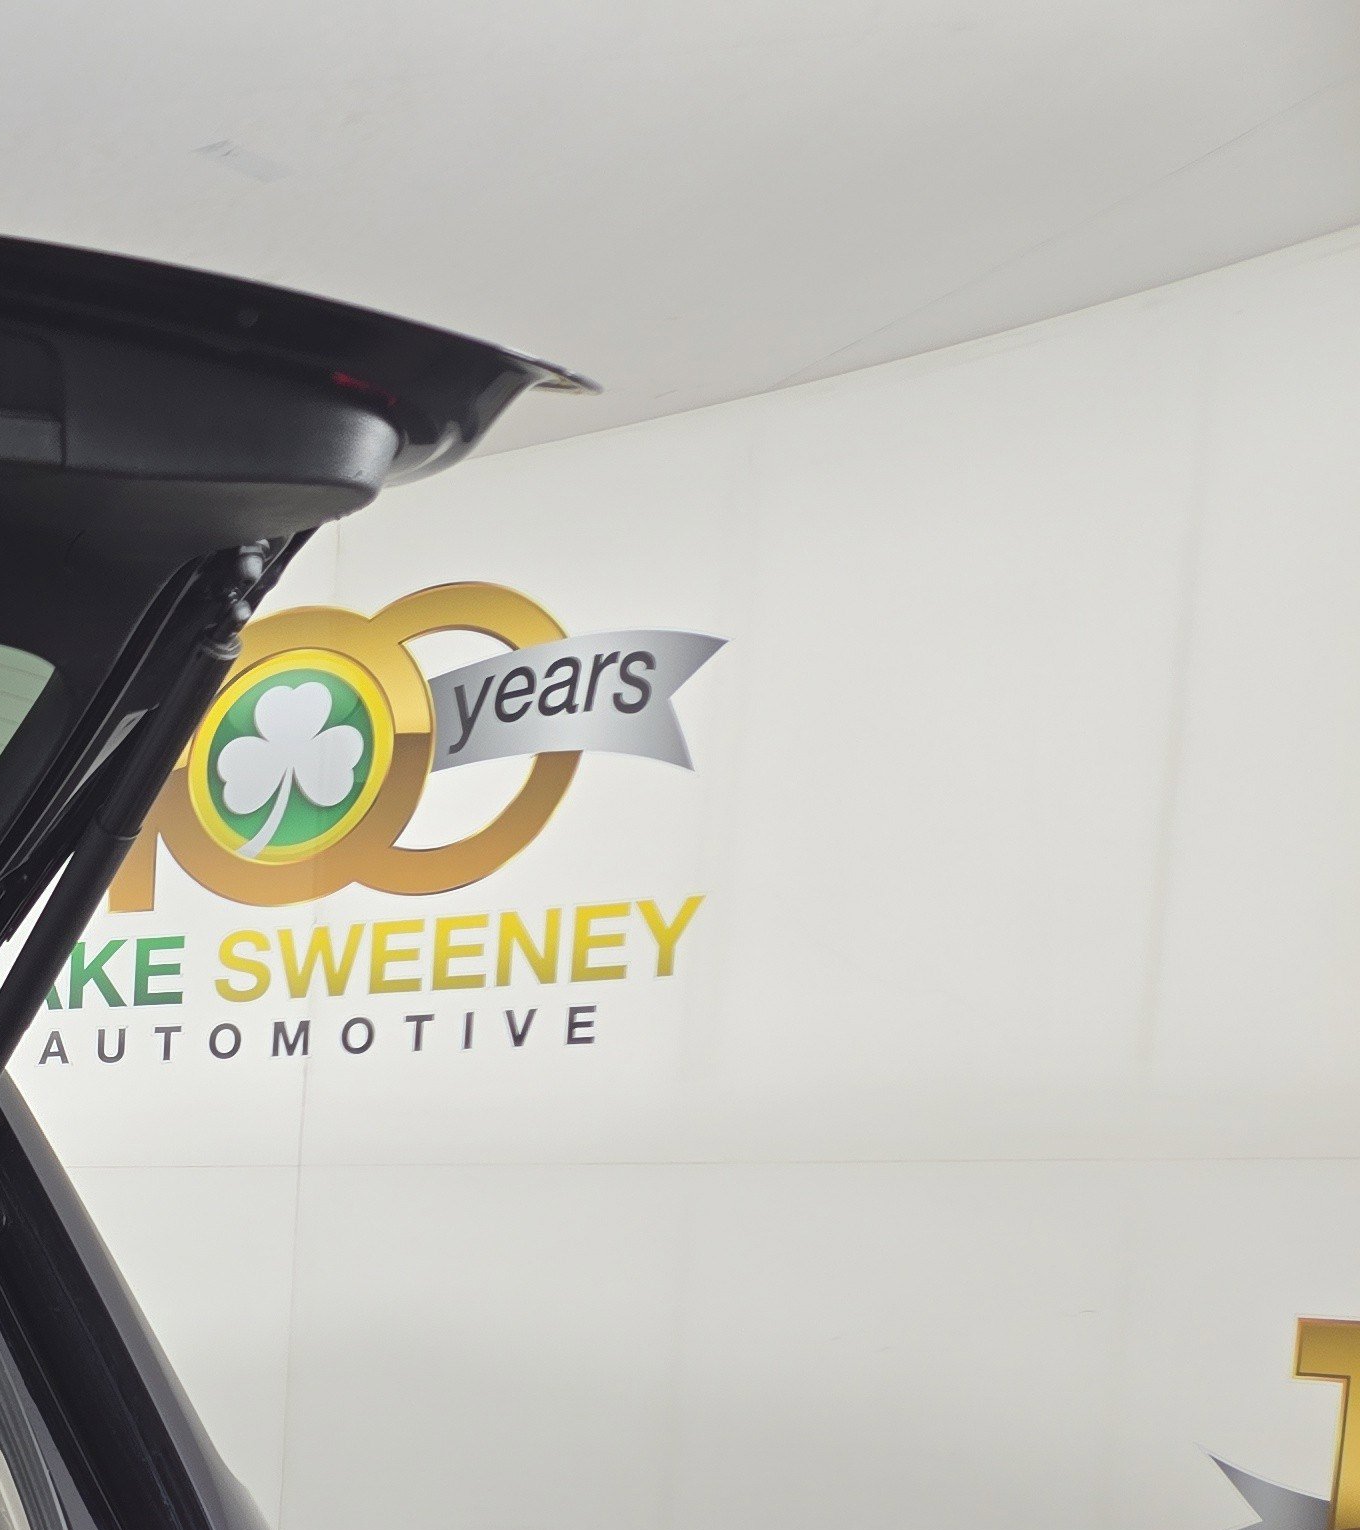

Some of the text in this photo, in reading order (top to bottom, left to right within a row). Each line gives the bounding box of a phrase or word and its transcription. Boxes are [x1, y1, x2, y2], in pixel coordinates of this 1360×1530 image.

[448, 647, 656, 754] years
[214, 895, 705, 1003] SWEENEY
[39, 1005, 597, 1066] AUTOMOTIVE
